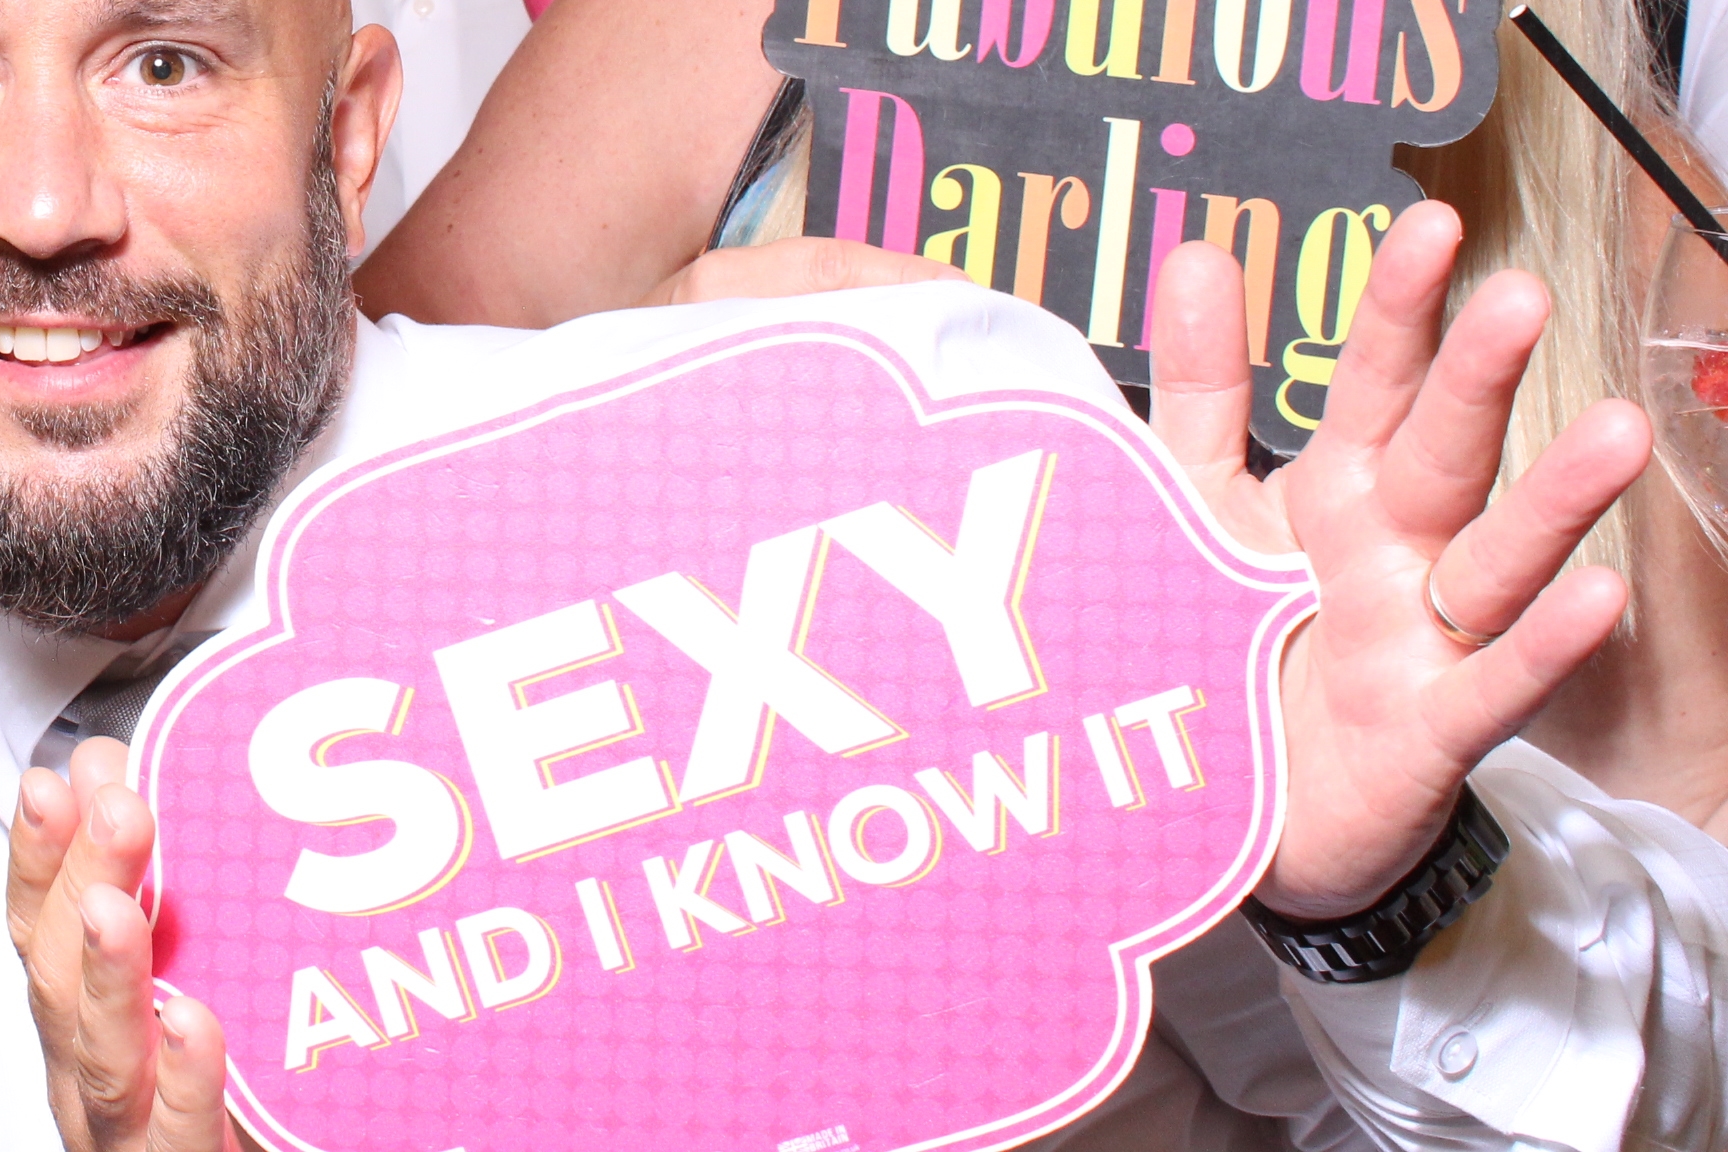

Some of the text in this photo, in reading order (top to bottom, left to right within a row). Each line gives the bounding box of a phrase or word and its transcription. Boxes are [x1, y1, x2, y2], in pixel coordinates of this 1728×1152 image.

[833, 87, 1390, 431] Darling
[247, 447, 1058, 917] SEXY
[283, 684, 1207, 1074] AND I KNOW IT
